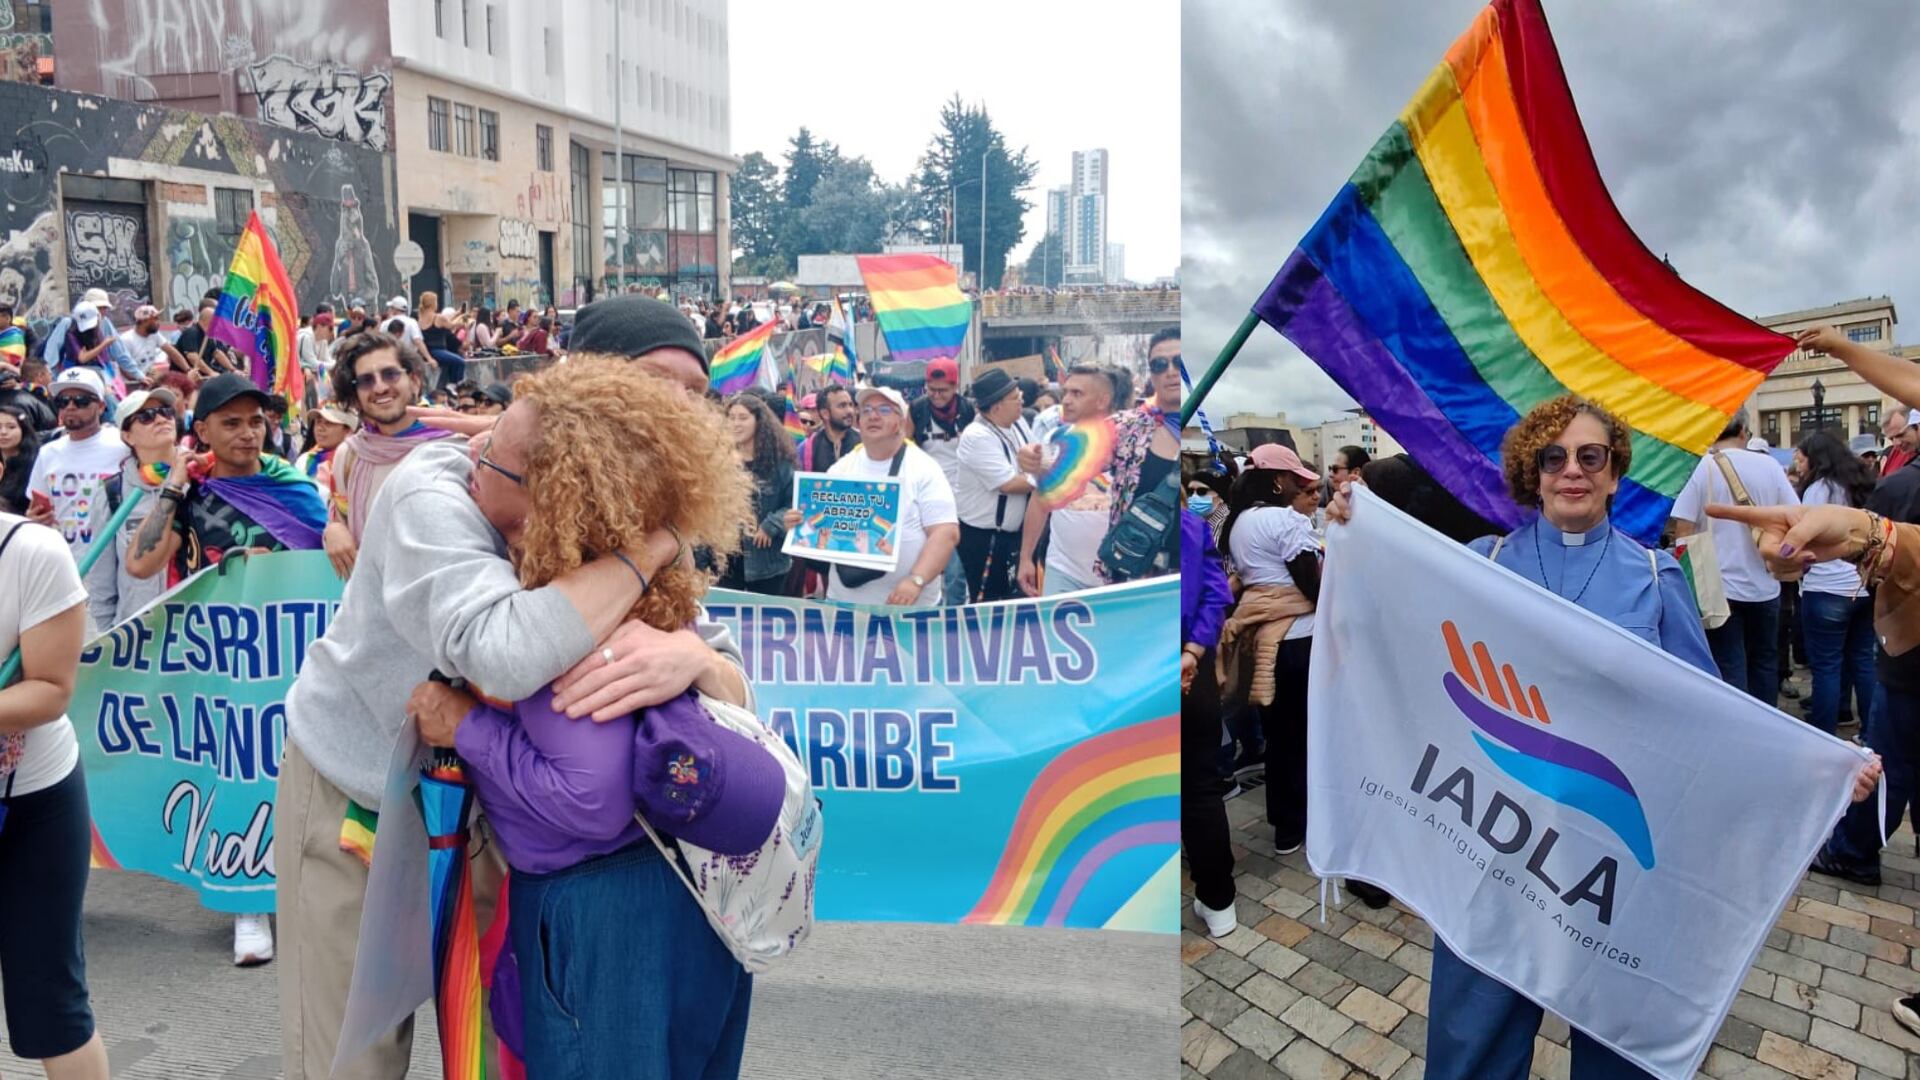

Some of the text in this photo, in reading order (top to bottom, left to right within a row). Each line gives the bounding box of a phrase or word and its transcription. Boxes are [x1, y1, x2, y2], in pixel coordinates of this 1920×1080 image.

[810, 491, 885, 506] RECLAMA TU
[823, 506, 872, 519] ABRAZO
[97, 690, 163, 756] DE
[1410, 743, 1619, 927] IADLA
[1359, 776, 1643, 970] Iglesia Antigua de las Americas
